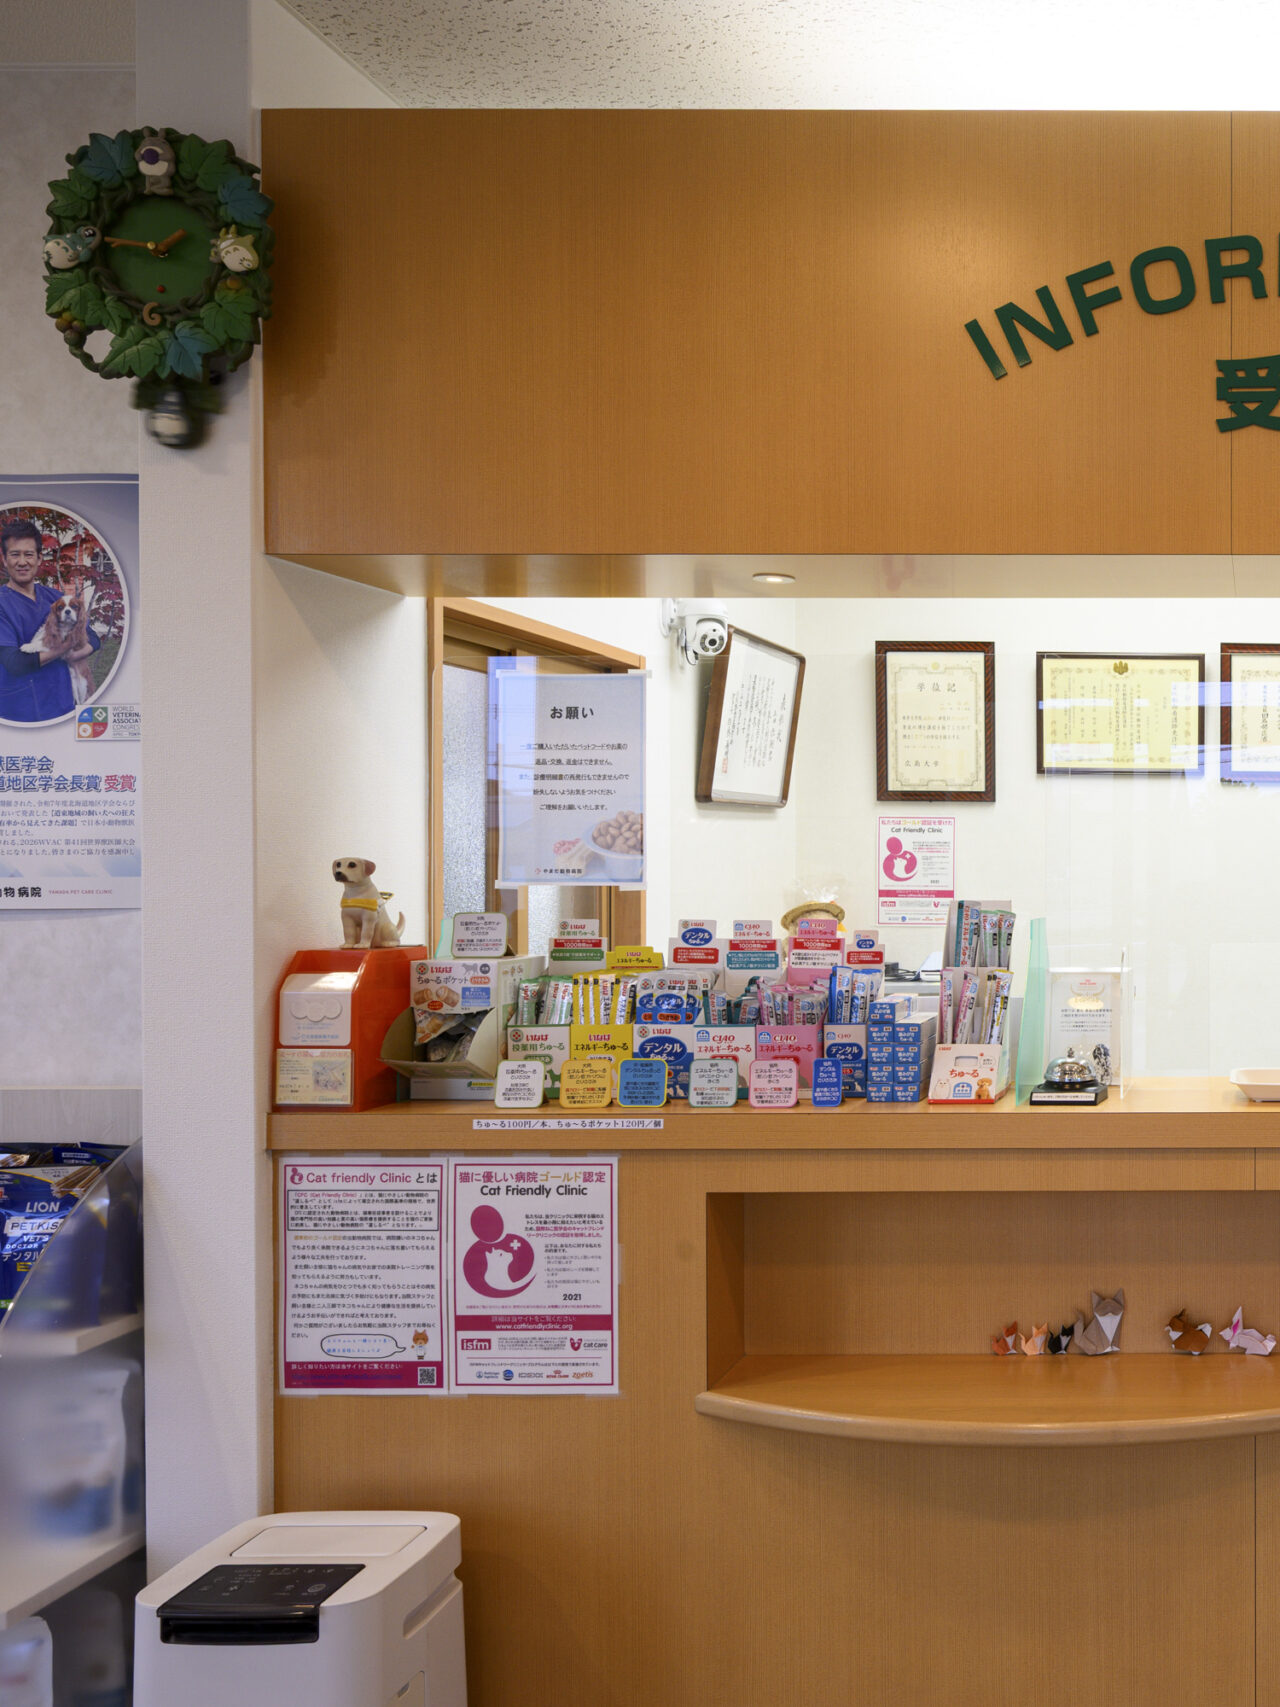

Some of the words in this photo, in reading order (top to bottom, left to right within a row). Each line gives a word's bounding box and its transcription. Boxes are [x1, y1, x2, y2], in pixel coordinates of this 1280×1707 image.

[550, 706, 594, 720] お願い
[104, 775, 136, 792] 受賞
[712, 1034, 736, 1043] CIAO
[774, 1034, 797, 1043] CIAO
[644, 1042, 683, 1053] デンタル
[832, 1046, 859, 1054] デンタル
[949, 1068, 980, 1078] ちゅ～る
[306, 1172, 327, 1184] Cat
[332, 1172, 376, 1185] friendly
[380, 1172, 412, 1184] Clinic
[416, 1172, 438, 1184] とは
[459, 1171, 606, 1184] 猫に優しい病院ゴールド認定
[480, 1185, 500, 1196] Cat
[506, 1184, 551, 1198] Friendly
[556, 1184, 588, 1196] Clinic
[26, 1202, 60, 1212] LION
[463, 1339, 490, 1350] isfm
